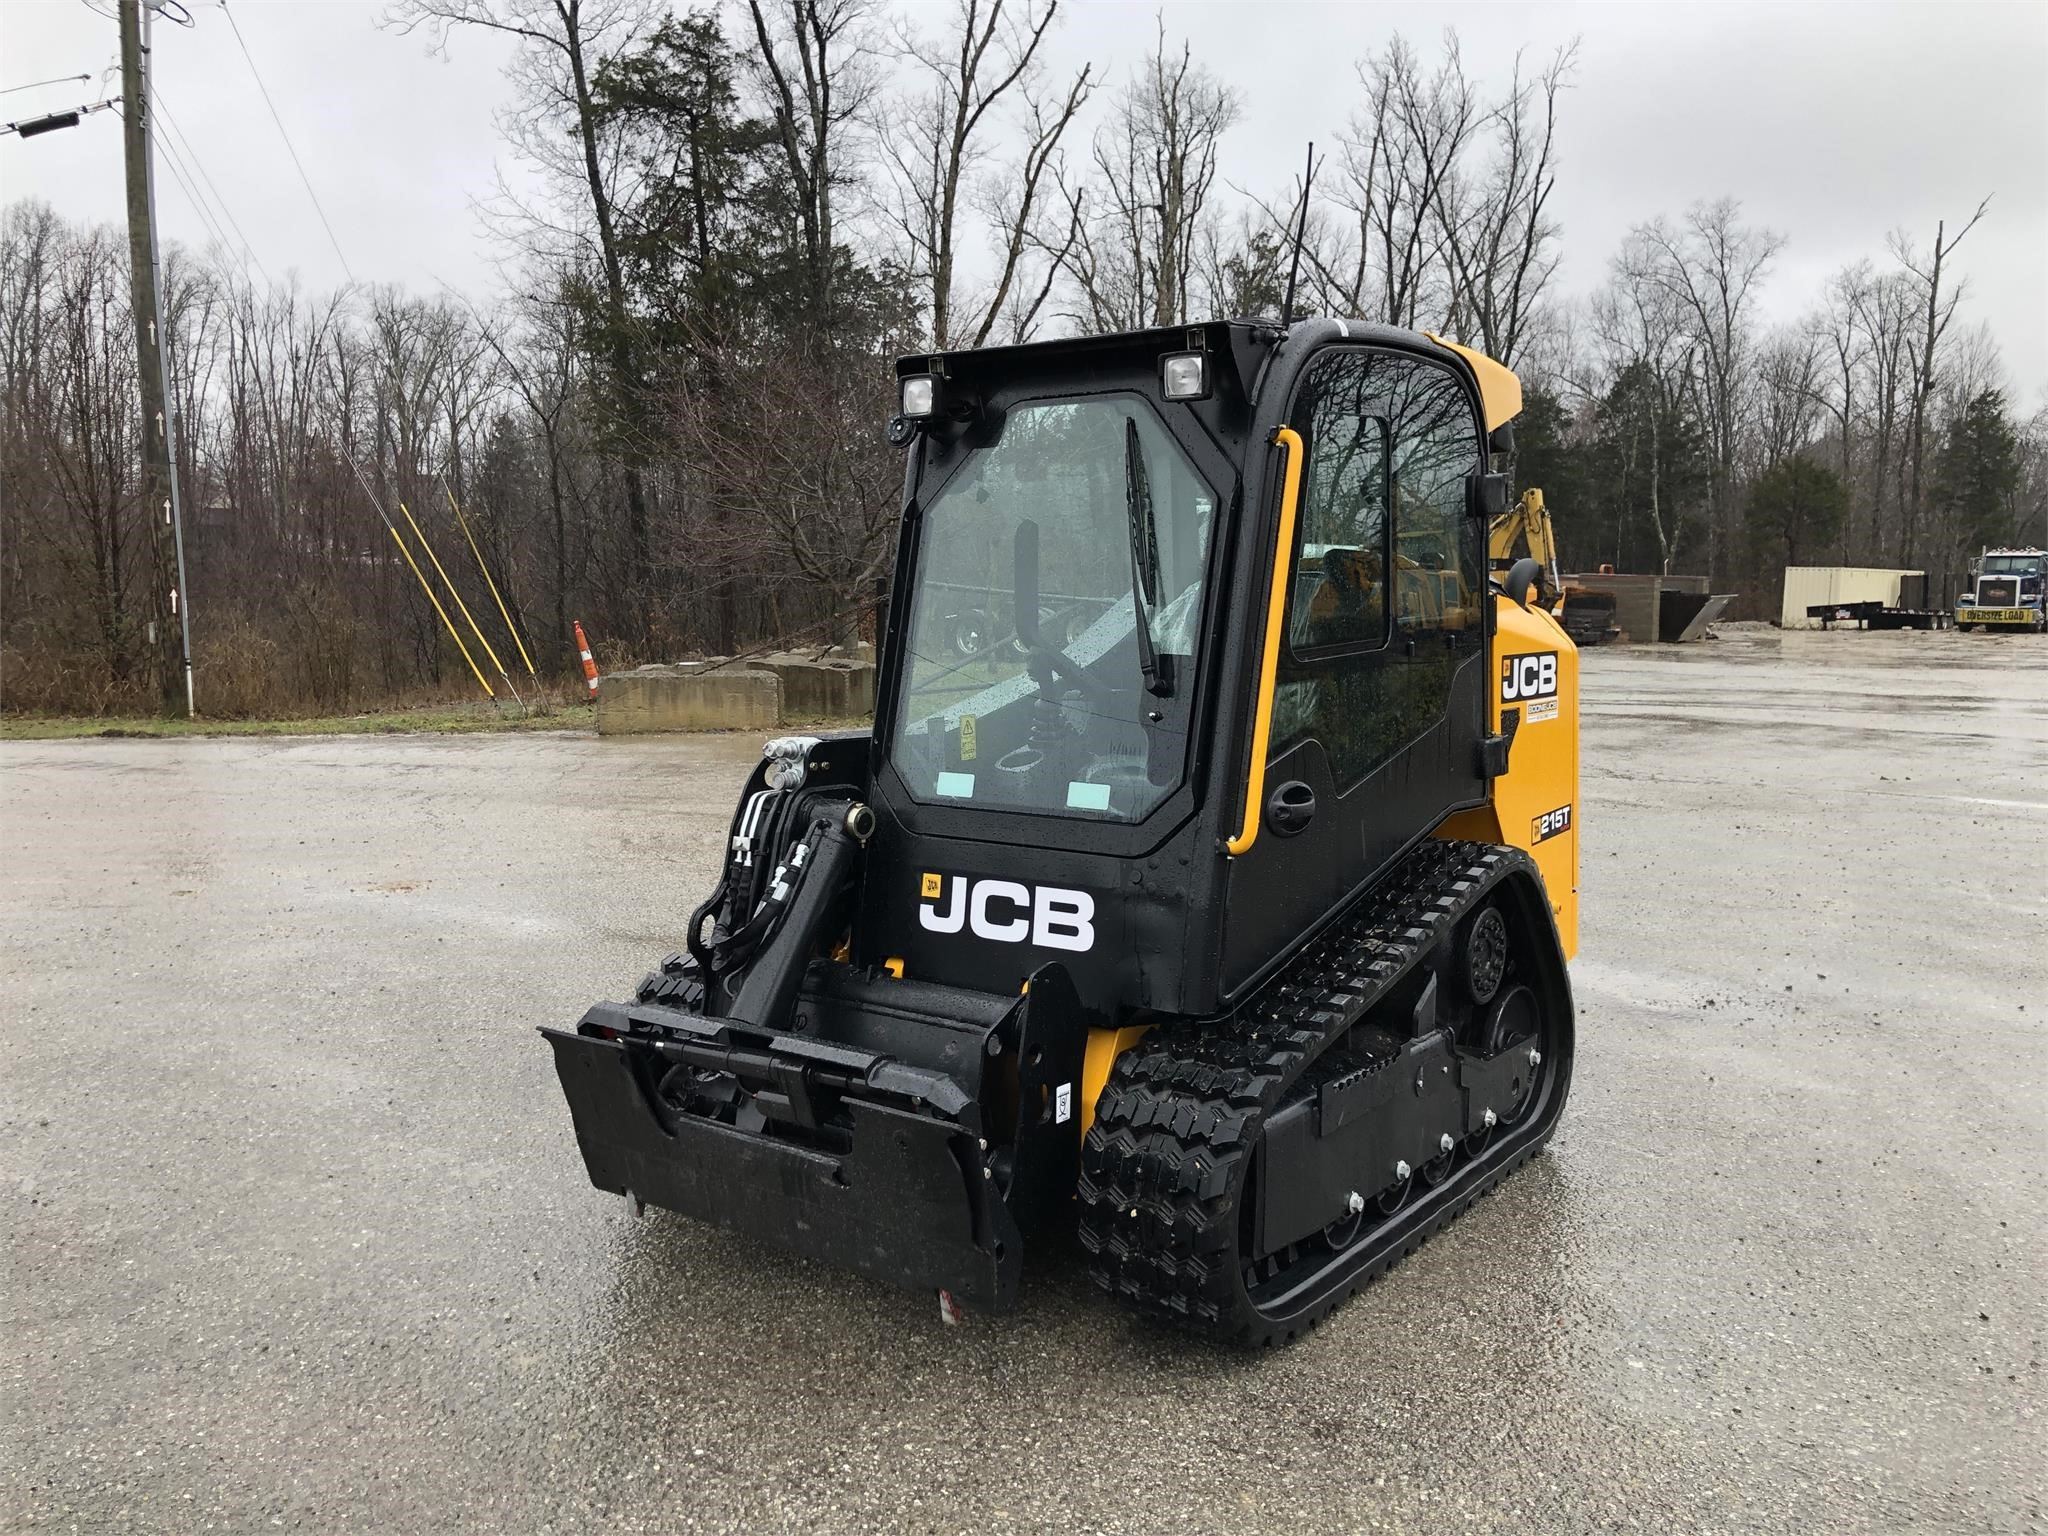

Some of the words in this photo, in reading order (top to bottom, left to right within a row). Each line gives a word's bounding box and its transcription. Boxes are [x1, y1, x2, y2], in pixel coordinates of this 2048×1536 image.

[1967, 610, 2002, 620] OVERSIZE
[2004, 610, 2024, 620] LOAD
[1502, 655, 1556, 699] JCB
[1541, 806, 1570, 835] 215T
[919, 876, 1095, 952] JCB
